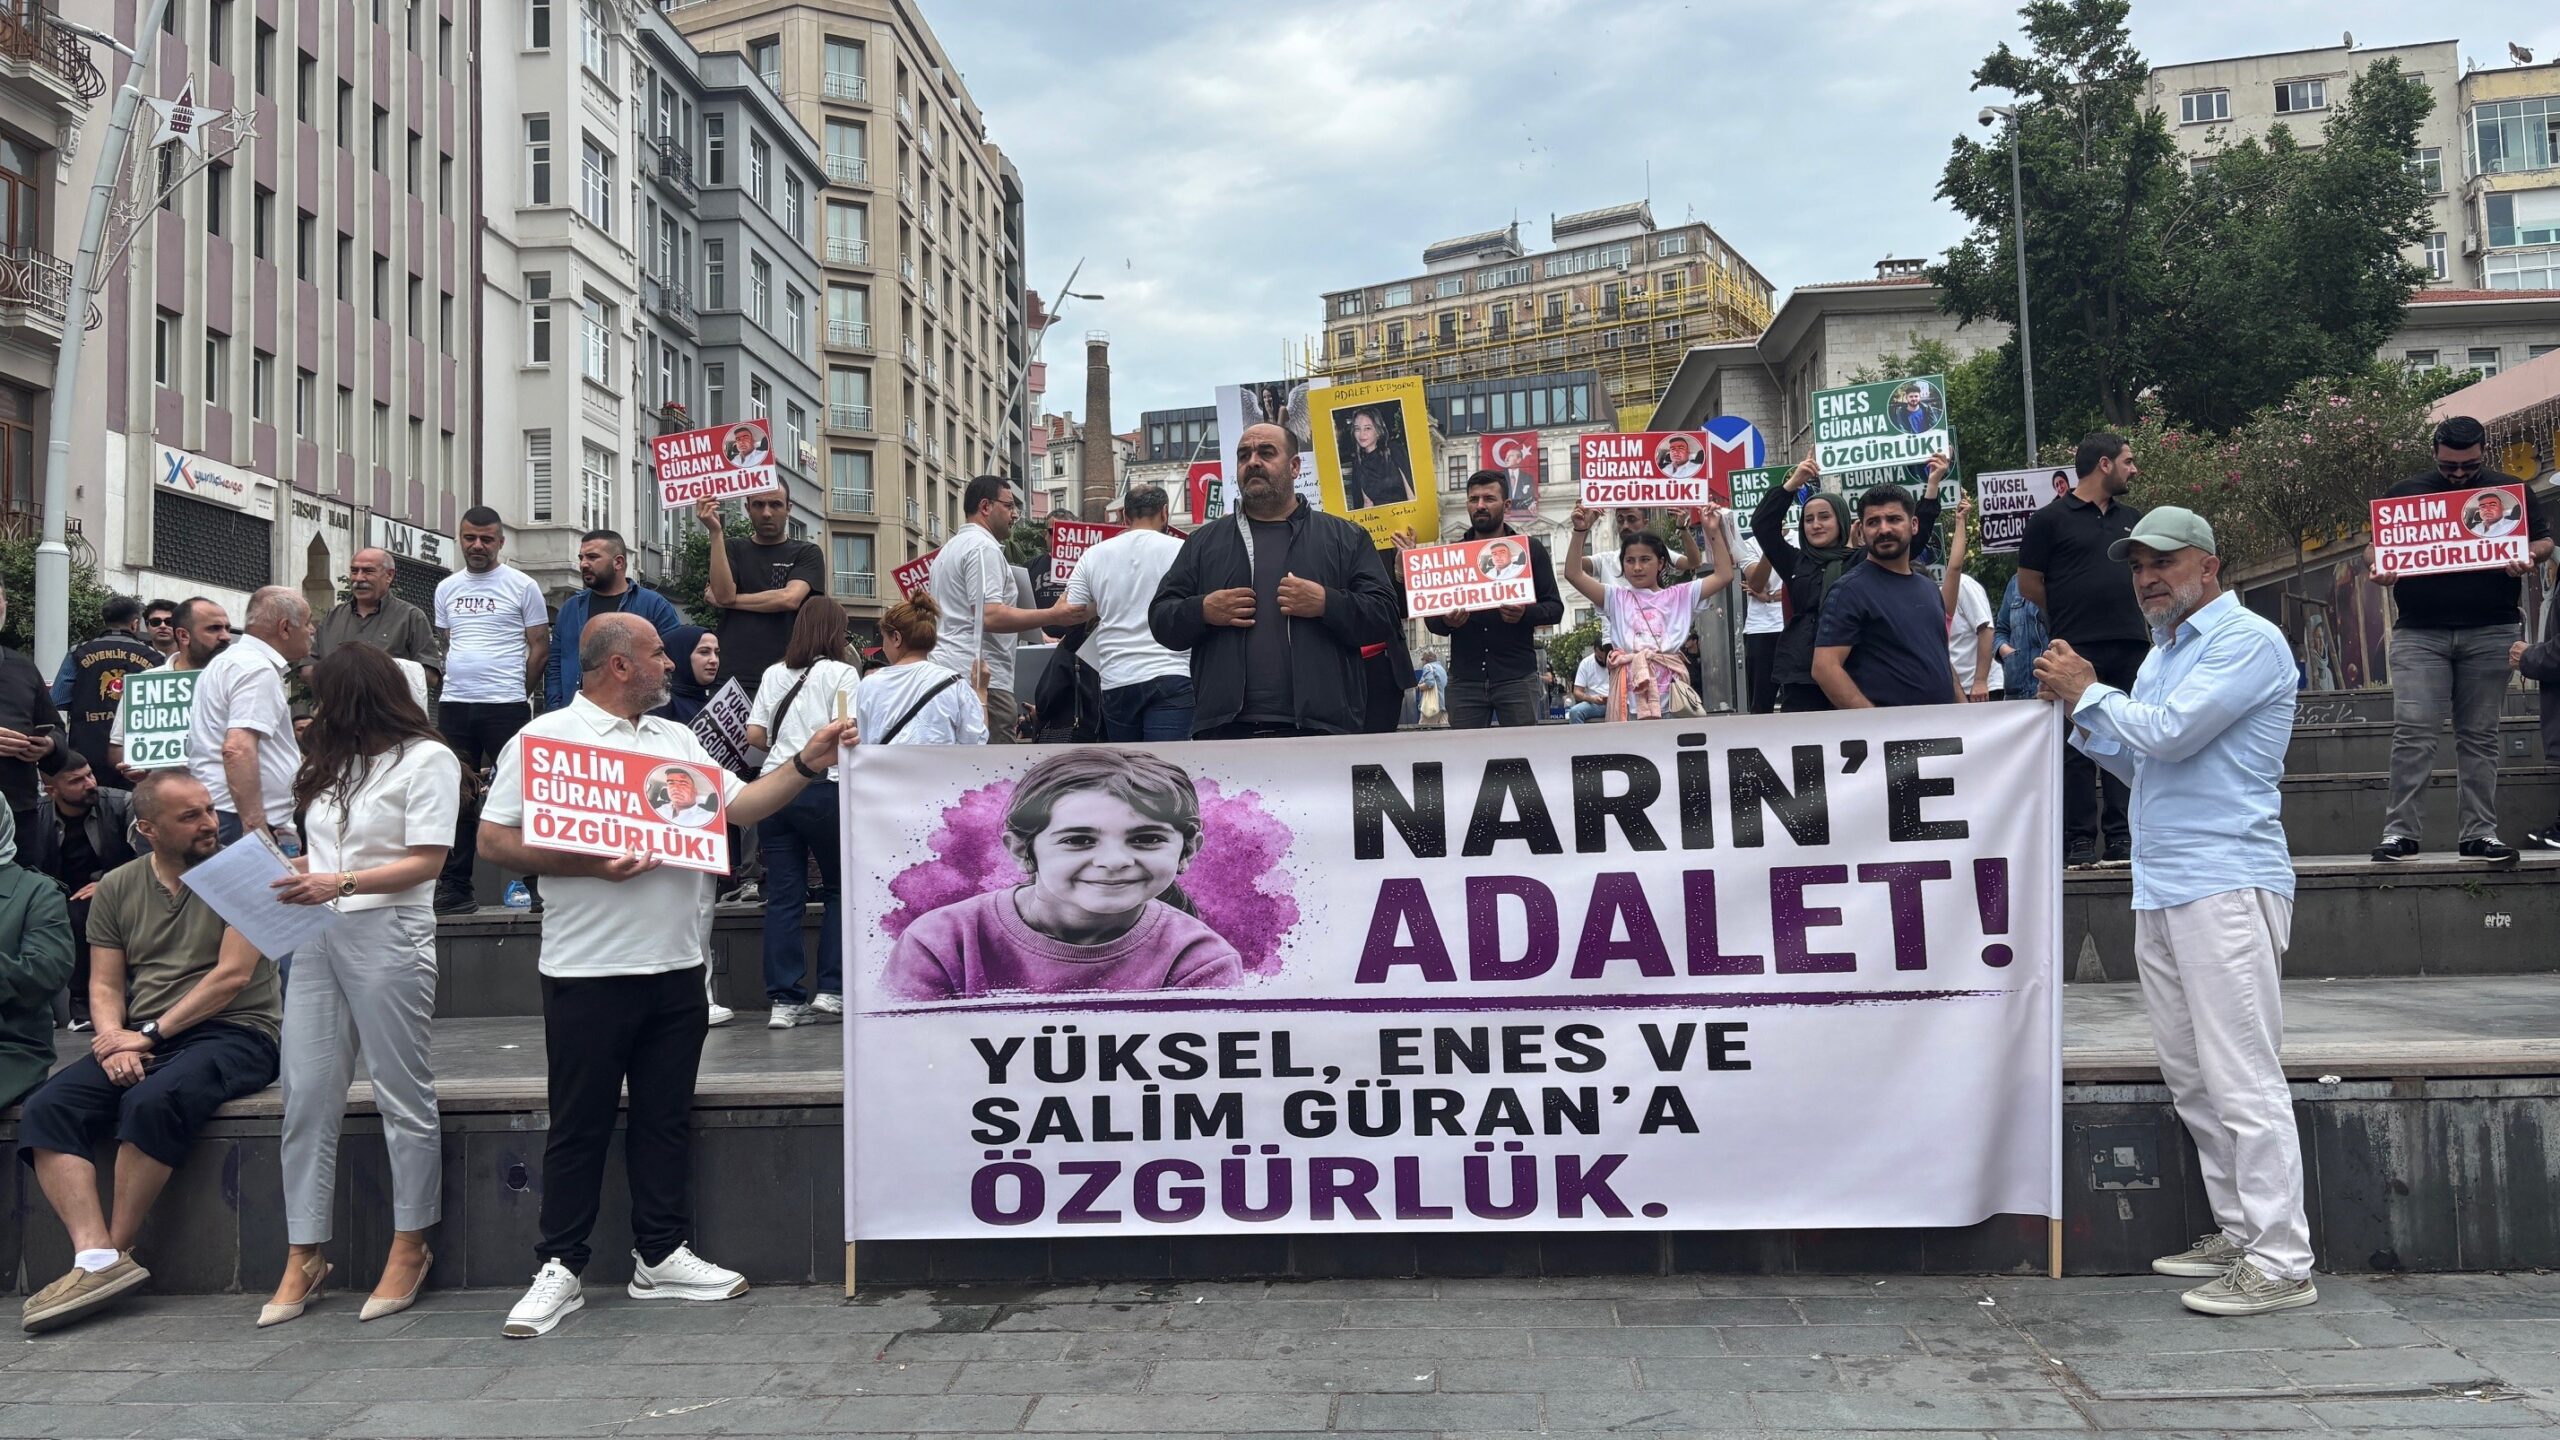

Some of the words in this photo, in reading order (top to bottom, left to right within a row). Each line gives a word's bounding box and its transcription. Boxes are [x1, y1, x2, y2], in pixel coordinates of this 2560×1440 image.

[1818, 391, 1870, 419] ENES
[1819, 414, 1888, 440] GÜRAN'A
[658, 434, 711, 460] SALİM
[1585, 436, 1643, 459] SALİM
[1821, 435, 1943, 468] ÖZGÜRLÜK!
[661, 454, 724, 480] GÜRAN'A
[1585, 458, 1654, 478] GÜRAN'A
[665, 469, 770, 503] ÖZGÜRLÜK!
[1586, 480, 1700, 503] ÖZGÜRLÜK!
[1733, 472, 1770, 493] ENES
[1982, 478, 2028, 495] YÜKSEL
[1983, 495, 2036, 512] GÜRAN'A
[2378, 499, 2447, 526] SALİM
[328, 510, 349, 531] HAN
[2380, 521, 2462, 546] GÜRAN'A
[1057, 526, 1103, 546] SALİM
[1056, 542, 1085, 560] GÜR
[1409, 548, 1466, 572] SALİM
[2382, 540, 2519, 572] ÖZGÜRLÜK!
[1411, 567, 1478, 590] GÜRAN'A
[456, 598, 496, 609] PUMA
[1413, 582, 1525, 612] ÖZGÜRLÜK!
[81, 648, 128, 669] GÜVENLİK
[131, 677, 191, 706] ENES
[724, 687, 750, 731] YÜKS
[531, 747, 625, 785] SALİM
[532, 771, 643, 816] GÜRAN'A
[1351, 733, 1970, 860] NARİN'E
[533, 807, 715, 862] ÖZGÜRLÜK!
[1354, 857, 2013, 984] ADALET!
[970, 1025, 1342, 1084] YÜKSEL,
[1379, 1022, 1605, 1076] ENES
[1638, 1021, 1752, 1073] VE
[970, 1084, 1244, 1145] SALİM
[1283, 1079, 1700, 1138] GÜRAN'A
[970, 1140, 1668, 1226] ÖZGÜRLÜK.
